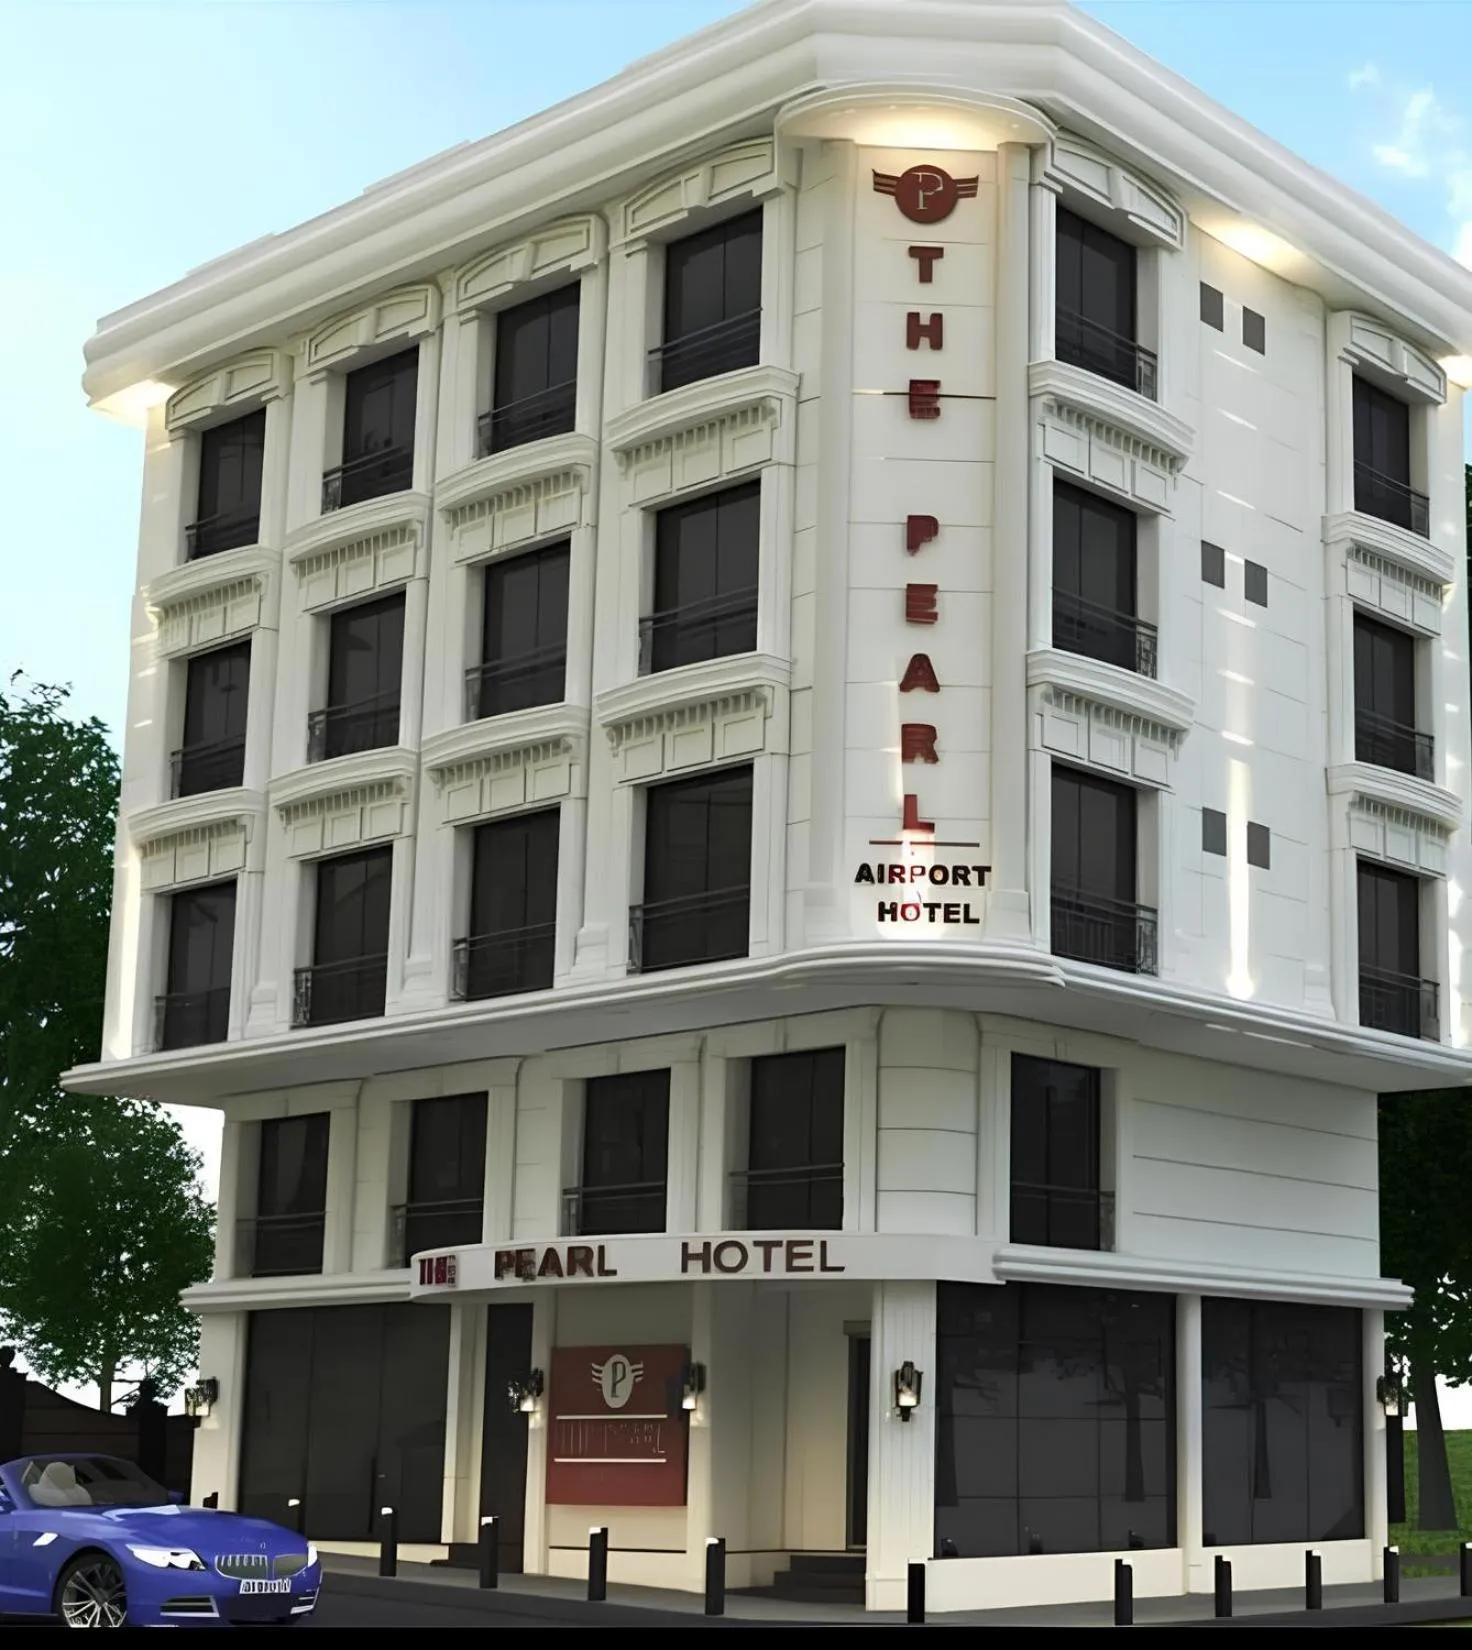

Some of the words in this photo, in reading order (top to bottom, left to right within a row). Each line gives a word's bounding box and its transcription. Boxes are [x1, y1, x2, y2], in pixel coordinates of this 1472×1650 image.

[907, 246, 945, 419] THE
[899, 514, 941, 833] PEARL
[854, 863, 992, 886] AIRPORT
[877, 901, 980, 924] HOTEL
[494, 1244, 618, 1282] PEARL
[681, 1240, 846, 1273] HOTEL
